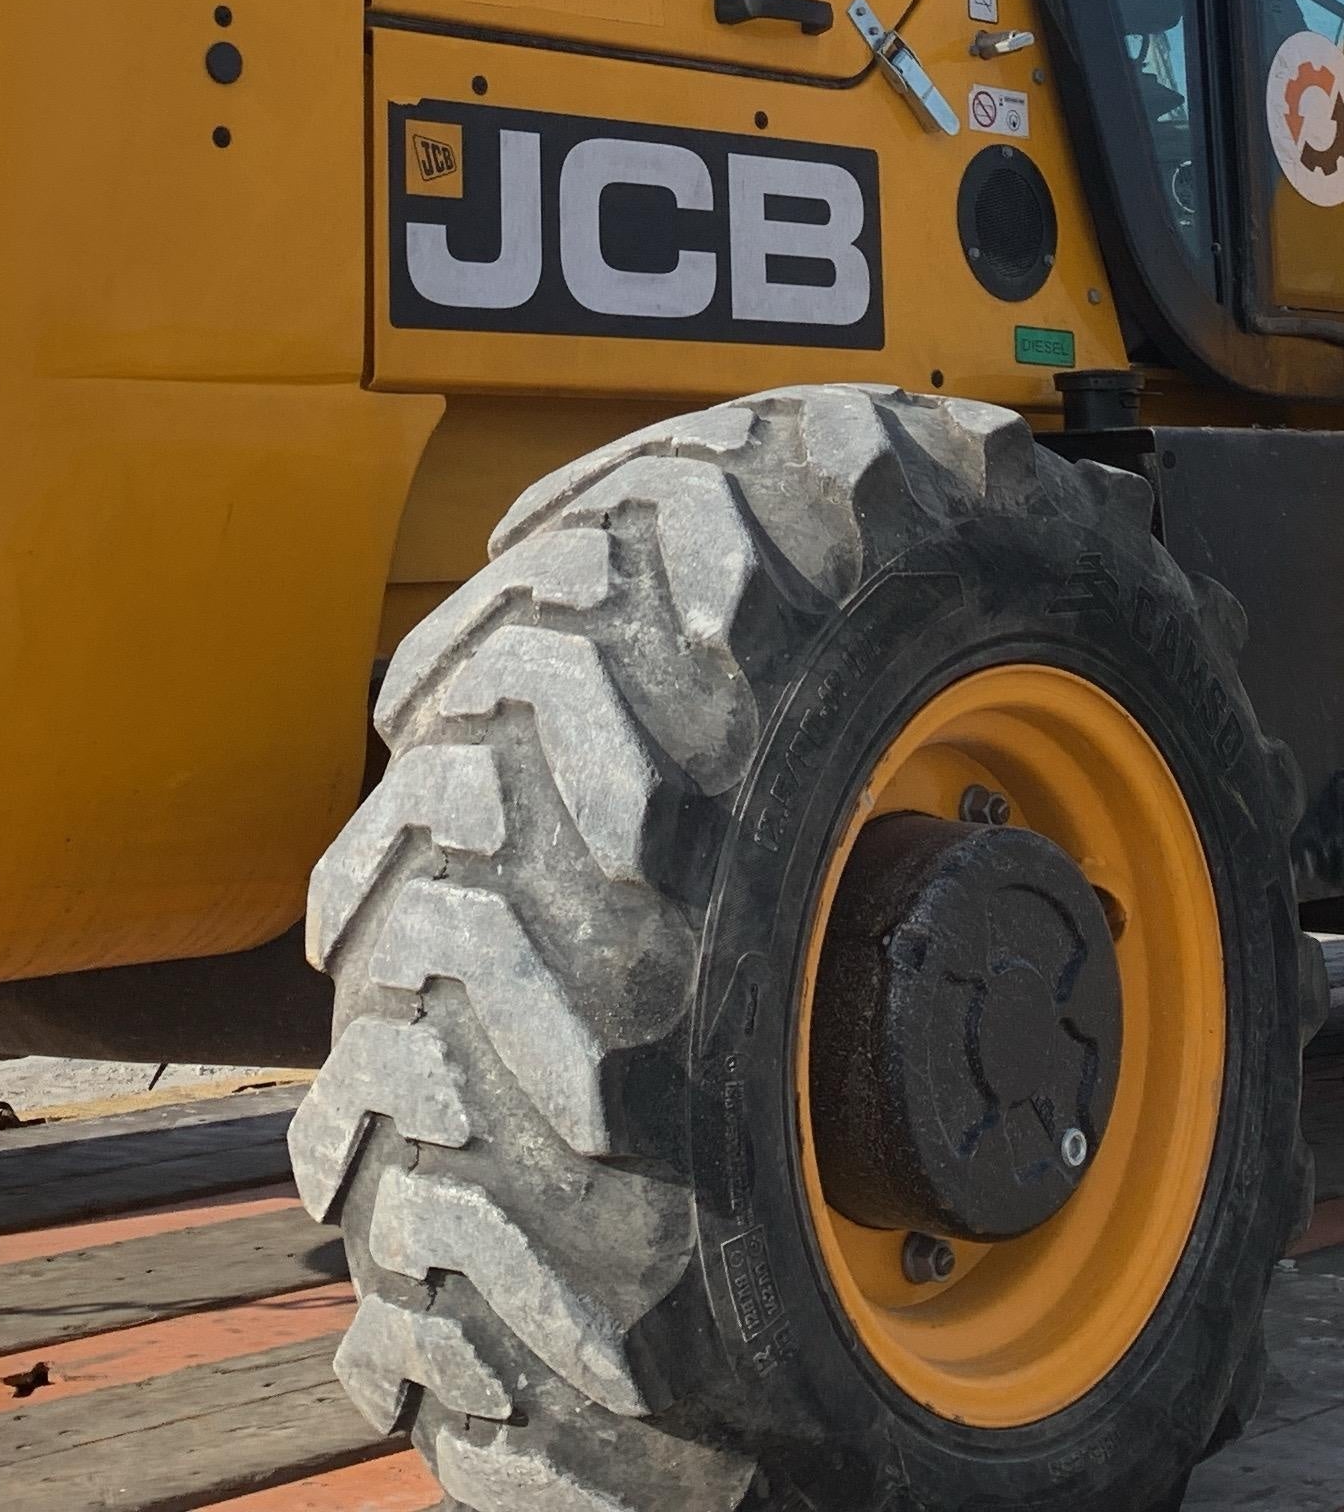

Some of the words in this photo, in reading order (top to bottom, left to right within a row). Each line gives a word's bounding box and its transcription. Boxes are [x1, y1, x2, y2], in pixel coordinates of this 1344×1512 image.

[421, 140, 455, 176] JCB
[405, 128, 871, 327] JCB
[1022, 337, 1070, 357] DIESEL
[1130, 586, 1246, 771] CAMSO
